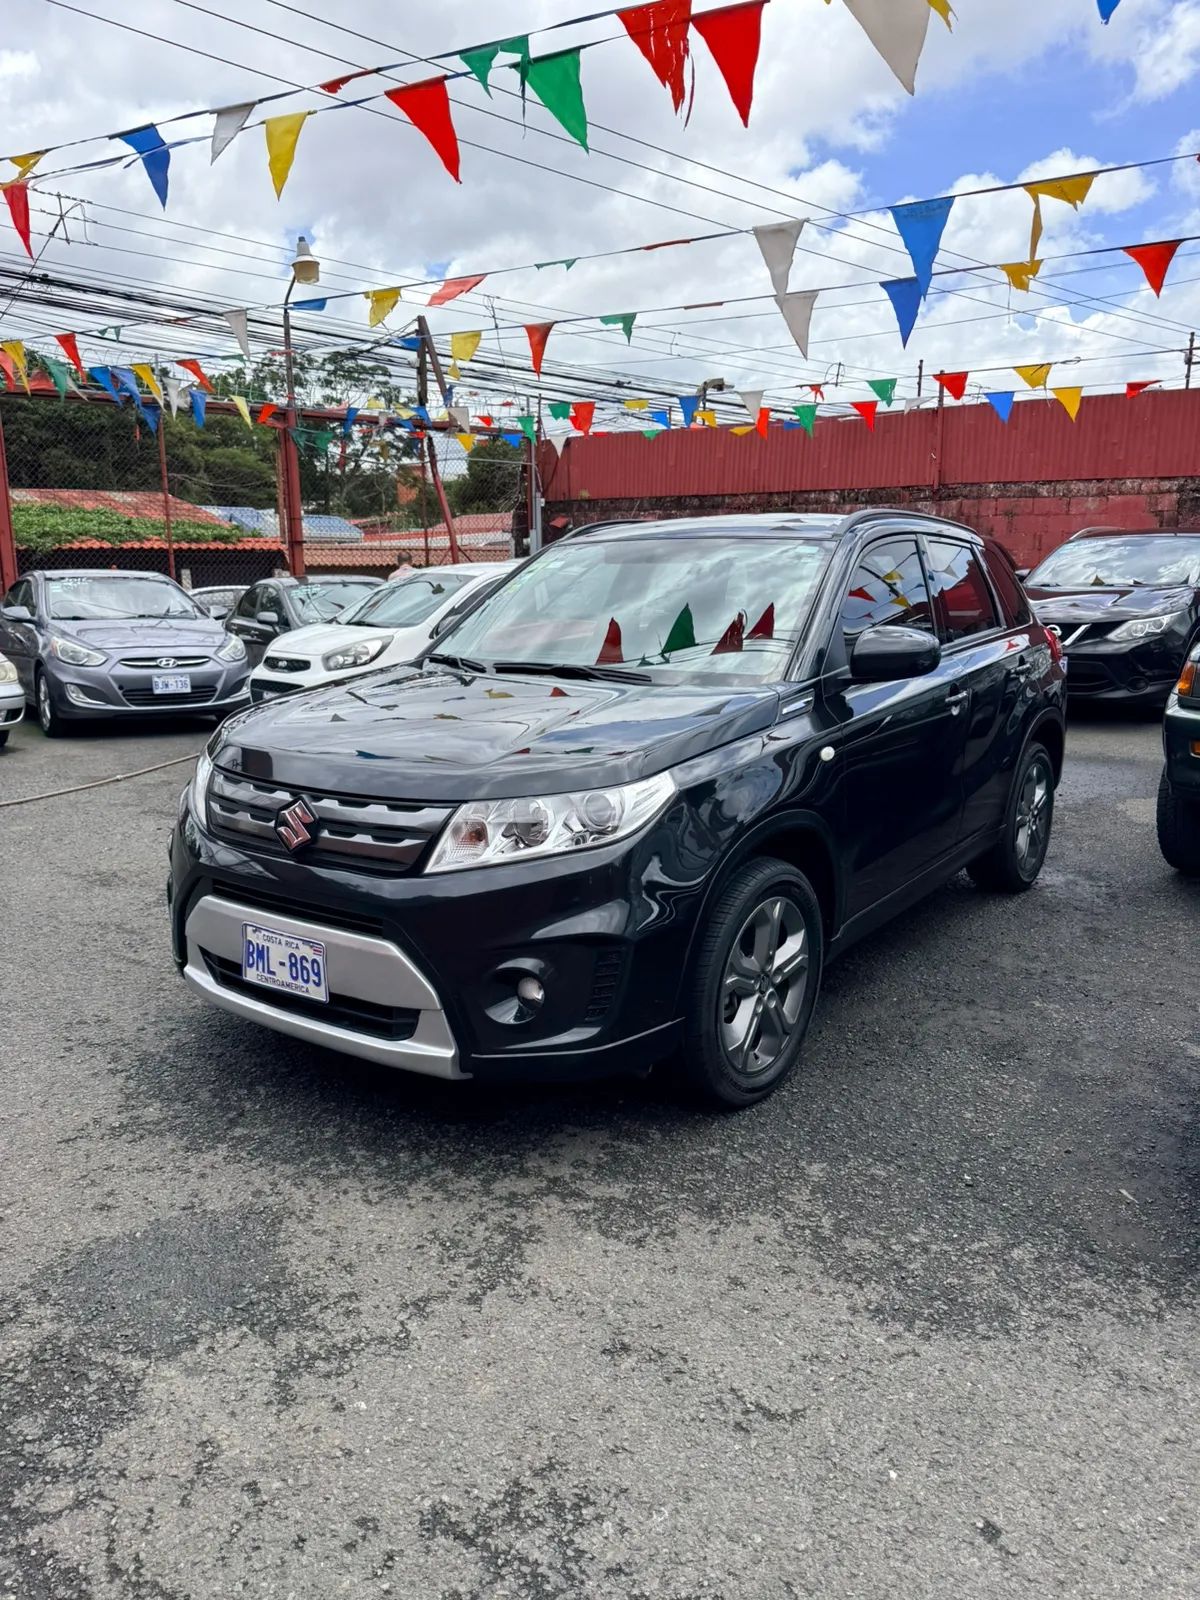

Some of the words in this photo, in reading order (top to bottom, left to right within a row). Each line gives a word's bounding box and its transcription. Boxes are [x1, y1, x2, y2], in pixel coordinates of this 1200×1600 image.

[262, 934, 282, 947] COSTA
[284, 940, 300, 950] RICA
[256, 973, 310, 994] CENTROAMERICA
